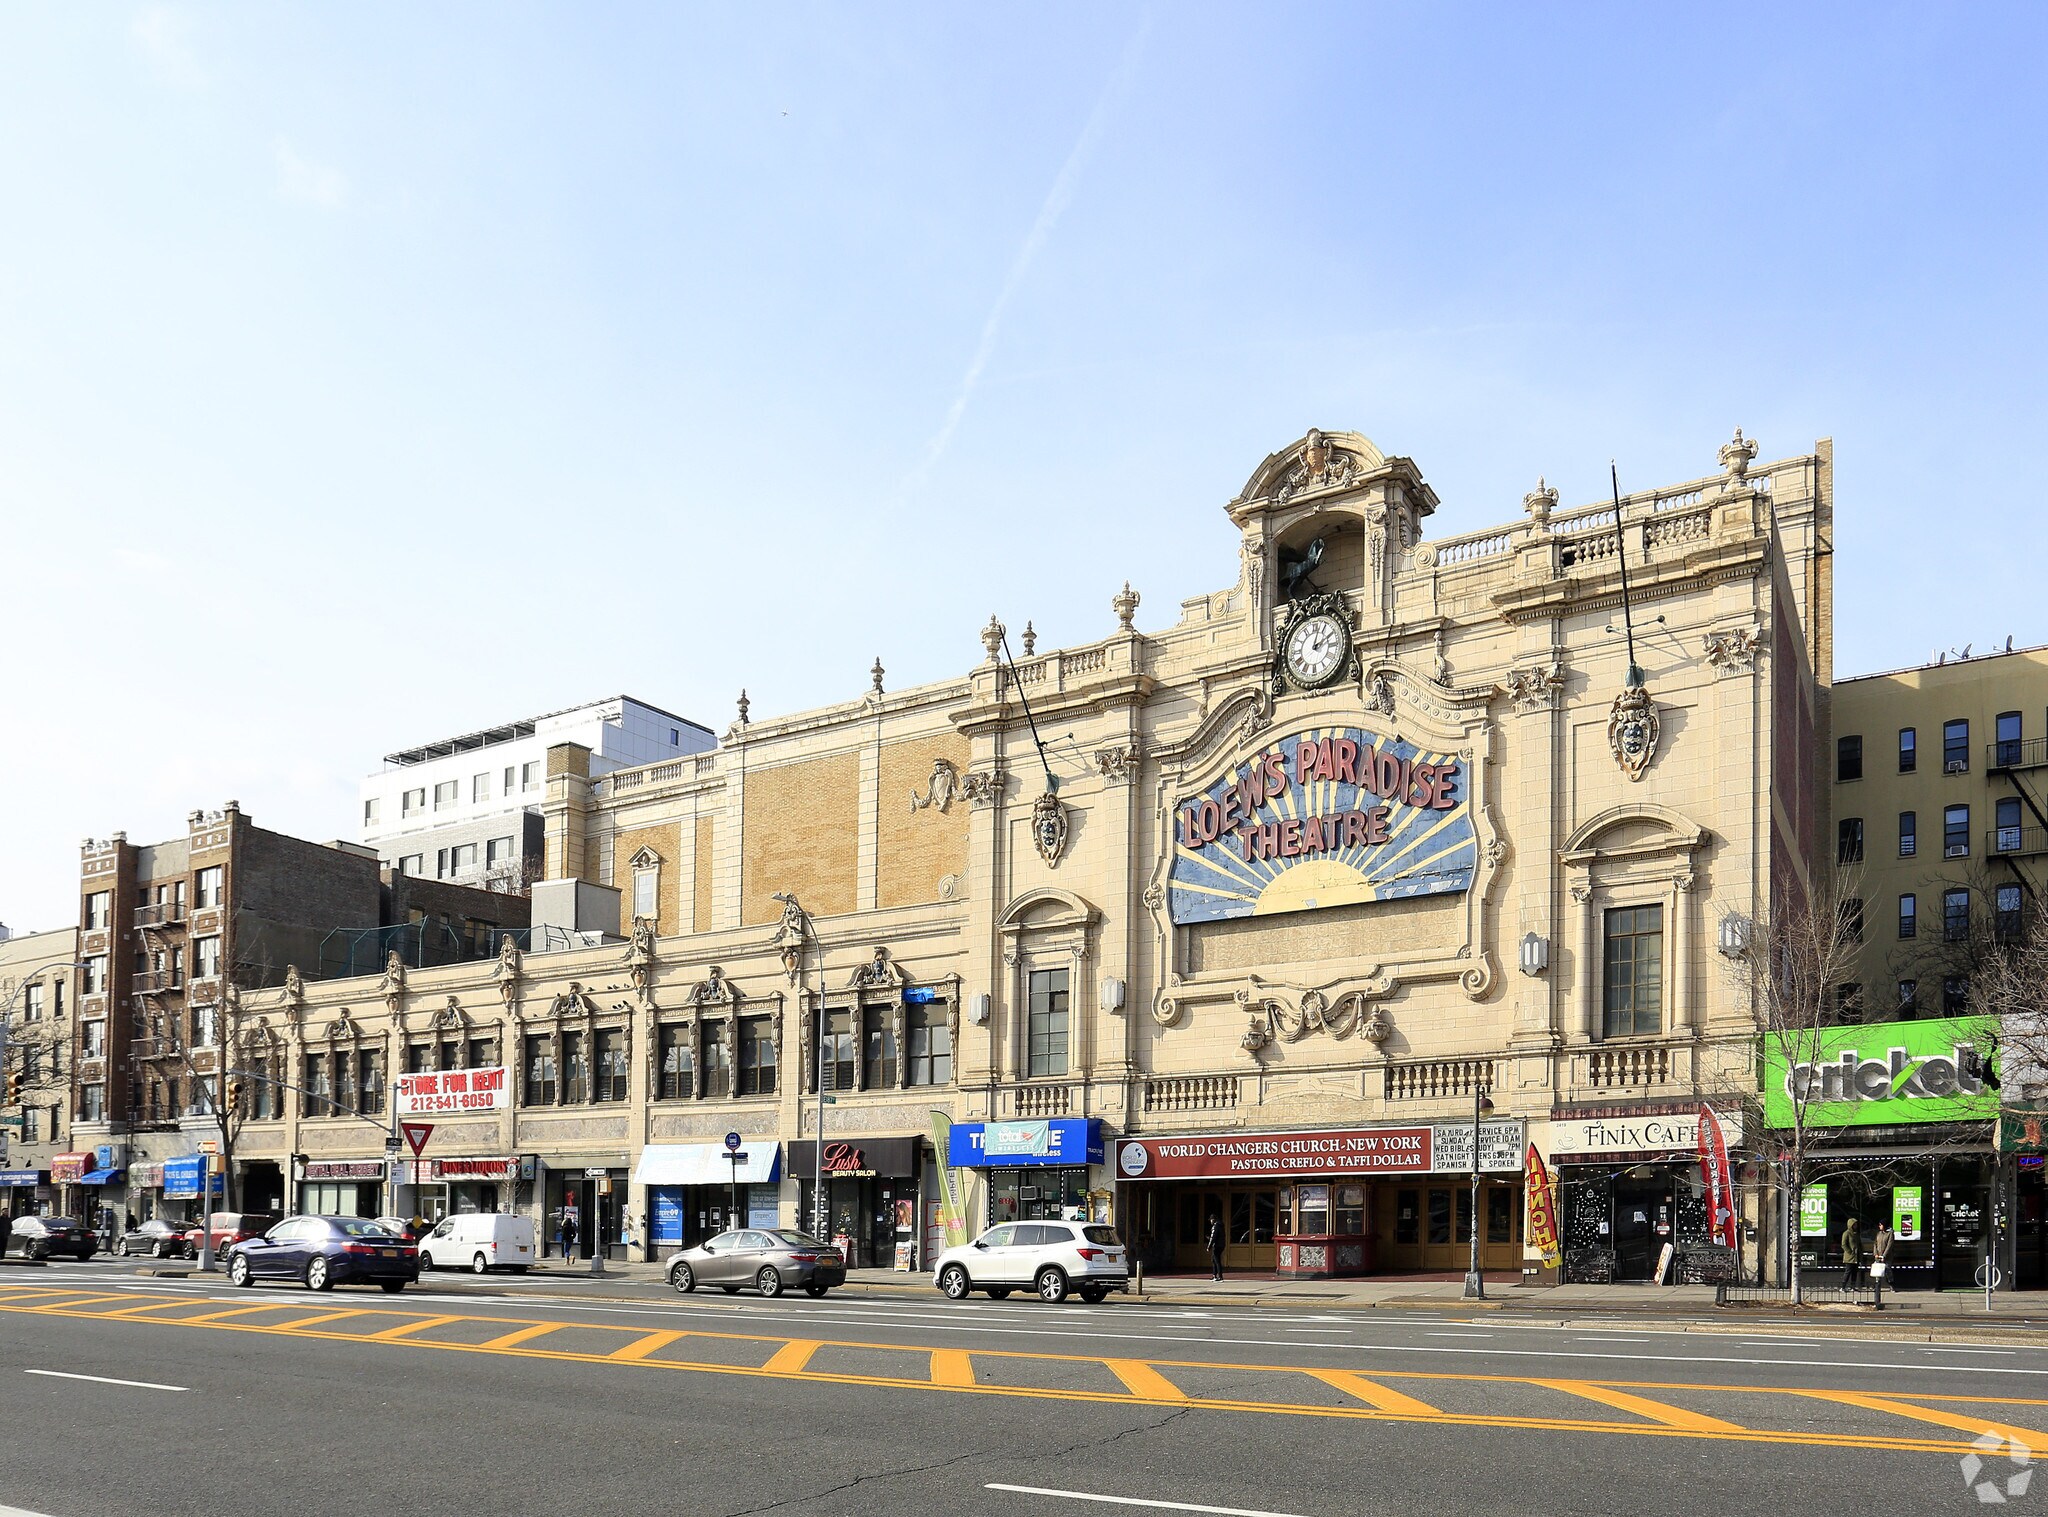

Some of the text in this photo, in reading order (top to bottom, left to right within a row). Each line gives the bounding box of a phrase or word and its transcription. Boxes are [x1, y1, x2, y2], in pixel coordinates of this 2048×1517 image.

[1184, 737, 1457, 849] LOEW'S PARADISE
[1239, 804, 1388, 862] THEATRE
[1784, 1043, 1982, 1103] cricket
[401, 1068, 505, 1096] STORE FOR RENT
[1479, 1127, 1502, 1135] ERVICE
[1504, 1126, 1519, 1134] 6PM
[1807, 1130, 1828, 1138] 2421
[1158, 1143, 1206, 1158] WORLD
[1207, 1141, 1278, 1156] CHANGERS
[1381, 1136, 1422, 1150] YORK
[1441, 1137, 1467, 1145] SUNDAY
[1473, 1135, 1500, 1143] SRVICE
[1508, 1142, 1521, 1150] 7PM
[821, 1143, 860, 1171] Lush
[1230, 1153, 1422, 1171] PASTORS CREFLO & TAFFI DOLLAR
[1437, 1160, 1515, 1169] SPANISH AL SPOKEN
[306, 1164, 330, 1178] DENTAL
[331, 1163, 349, 1177] ORAL
[349, 1162, 379, 1176] SURGERY
[442, 1161, 461, 1173] WINE
[471, 1160, 508, 1174] LIQUORS
[832, 1169, 876, 1177] BEAUTY SALON
[1800, 1198, 1827, 1214] $100
[1895, 1197, 1920, 1207] FREE
[1951, 1209, 1979, 1217] cricket
